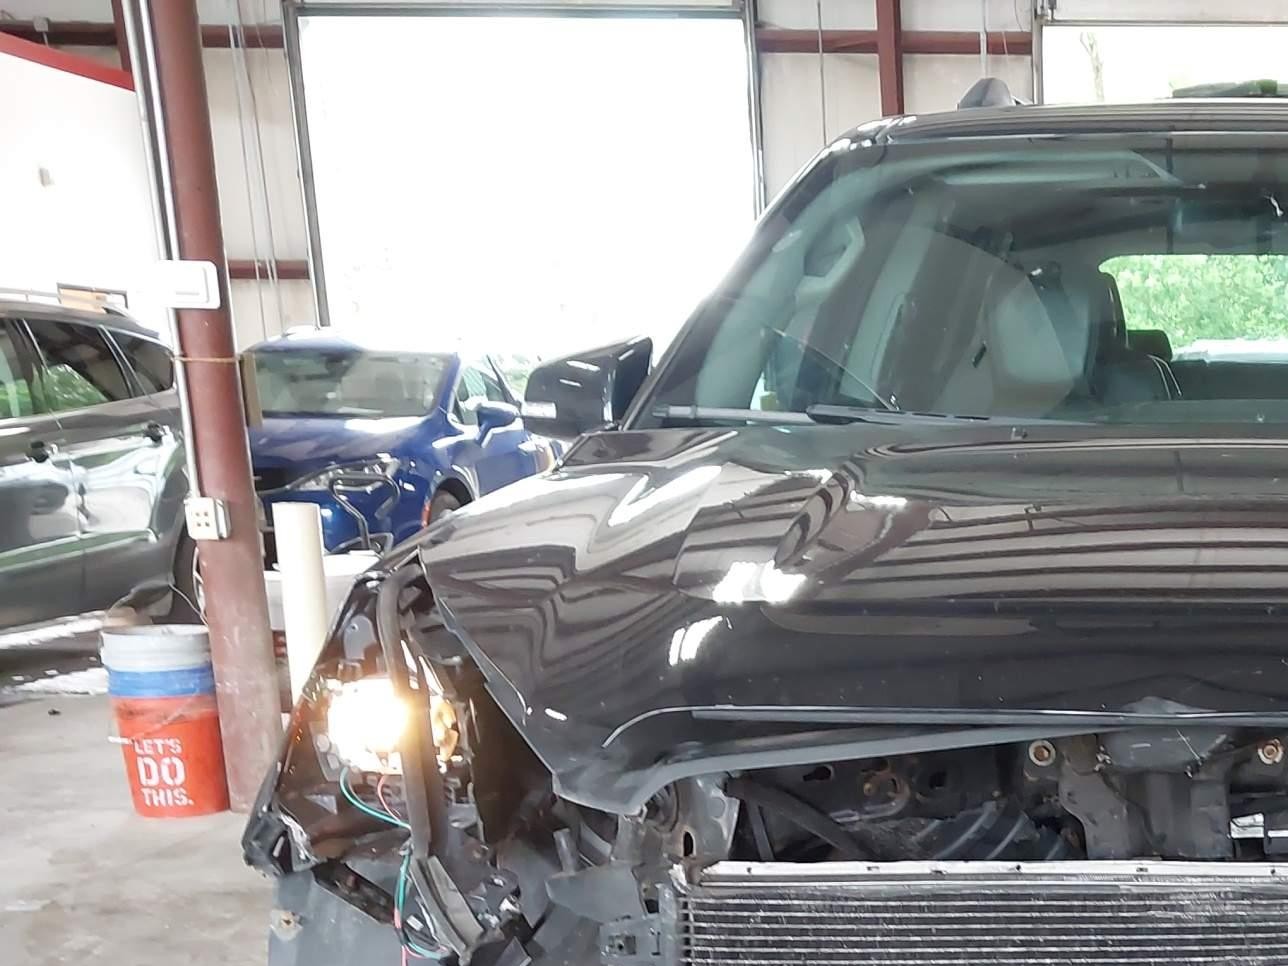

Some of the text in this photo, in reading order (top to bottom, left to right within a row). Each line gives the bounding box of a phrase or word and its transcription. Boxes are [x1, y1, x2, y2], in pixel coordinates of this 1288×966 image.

[134, 738, 182, 755] LET'S
[137, 756, 186, 787] DO
[141, 787, 195, 807] THIS.
